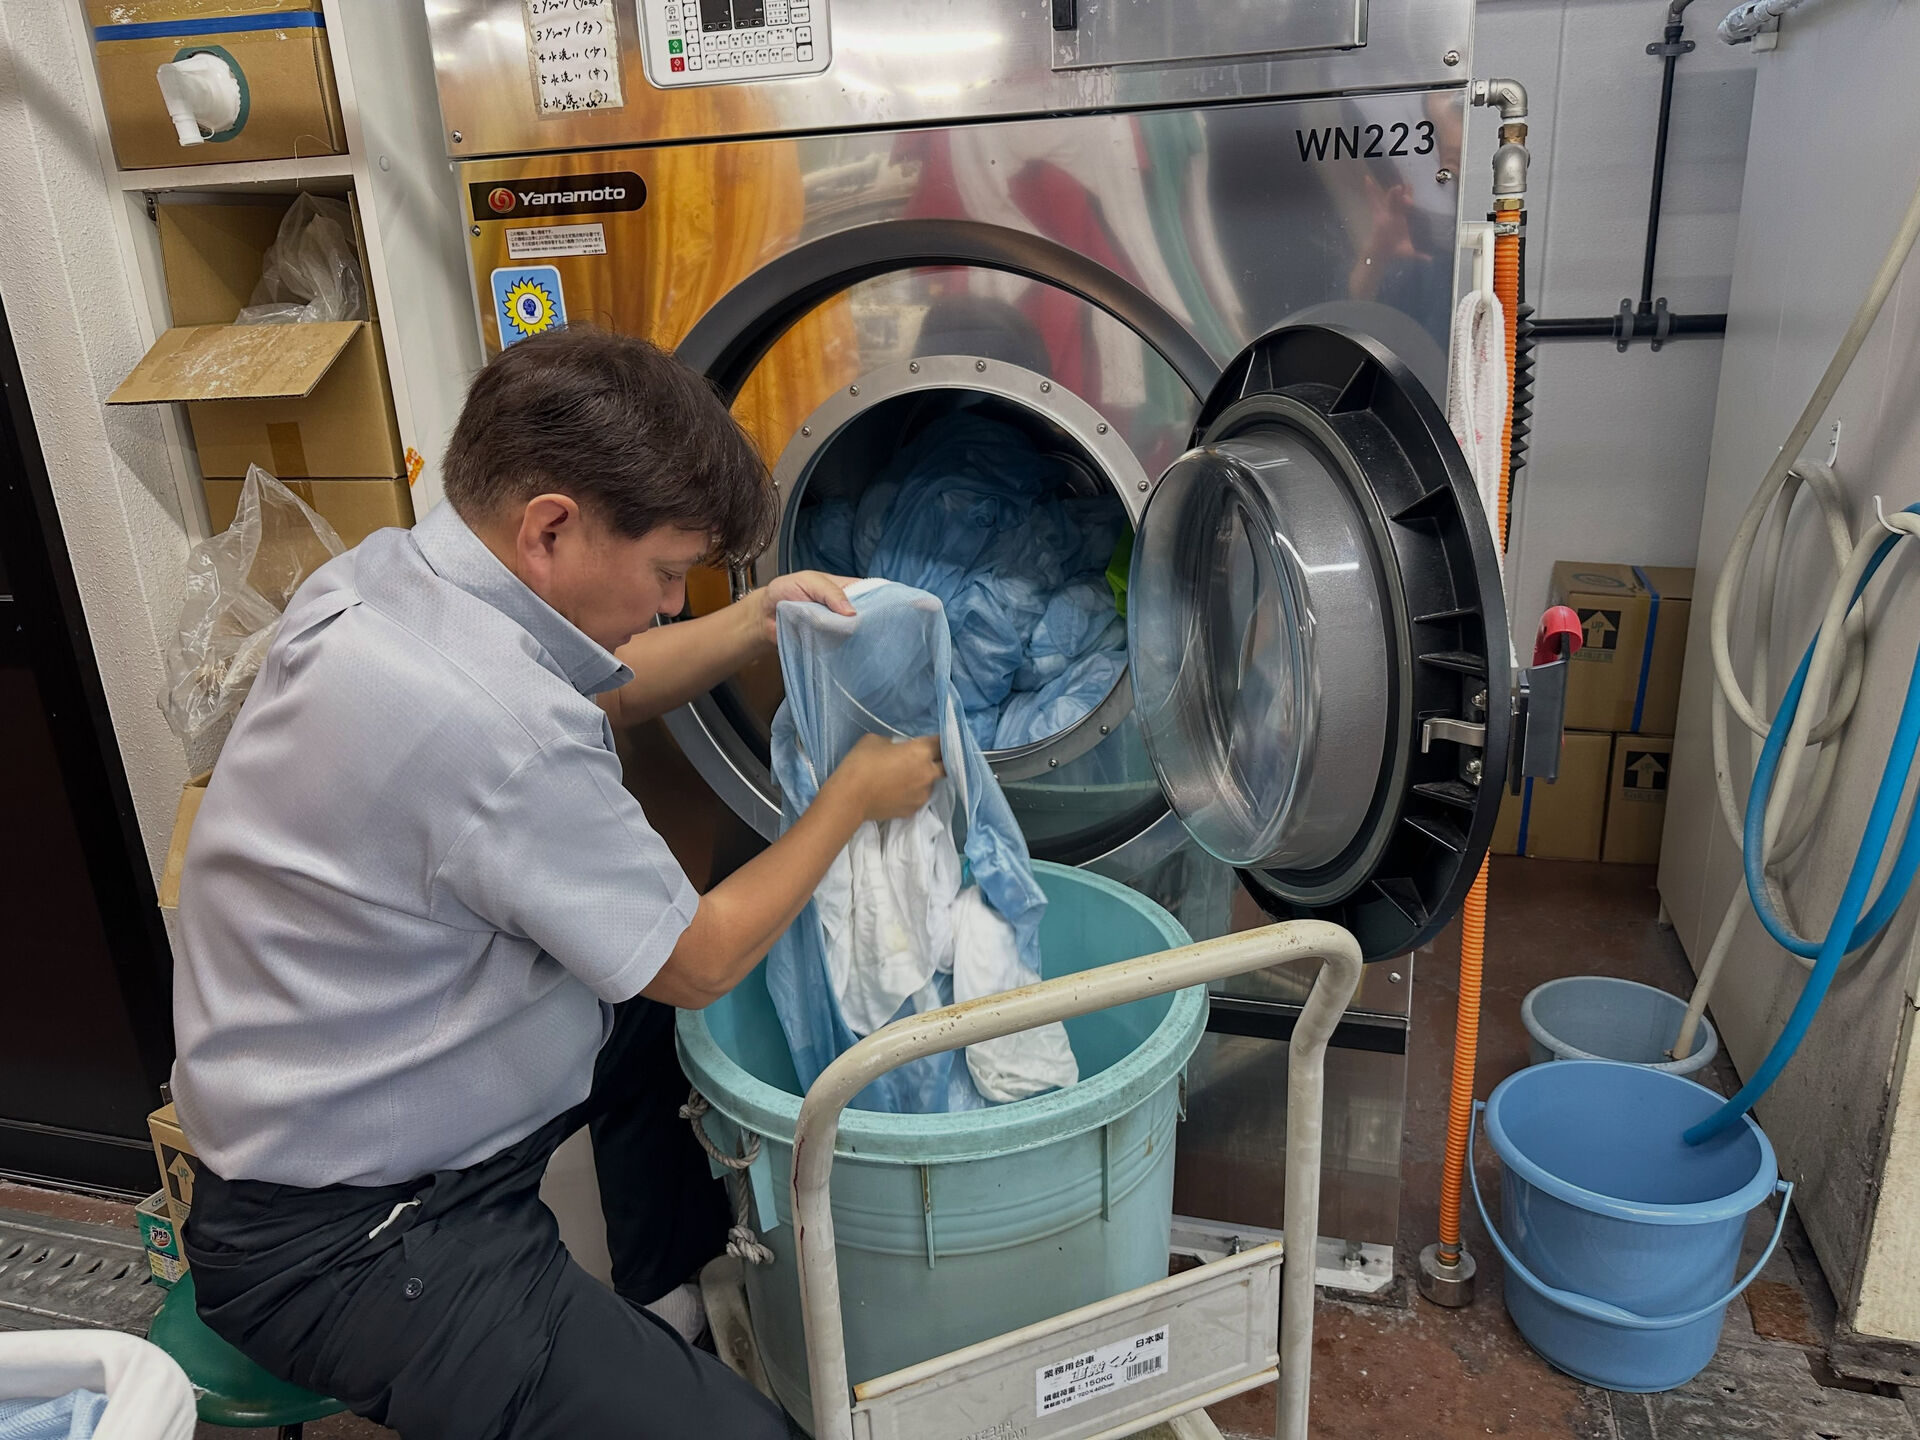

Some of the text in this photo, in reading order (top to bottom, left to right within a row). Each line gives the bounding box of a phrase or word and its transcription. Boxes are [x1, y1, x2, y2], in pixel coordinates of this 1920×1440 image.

[536, 30, 542, 41] 3
[538, 53, 546, 63] 4
[548, 48, 579, 62] 水洗い
[541, 74, 548, 85] 5
[550, 70, 581, 86] 水洗い
[543, 98, 549, 109] 6
[1295, 120, 1435, 162] WN223
[518, 186, 626, 206] Yamamoto
[177, 1165, 190, 1185] UP
[1135, 1331, 1165, 1349] 日本製
[1043, 1354, 1095, 1380] 業務用台車
